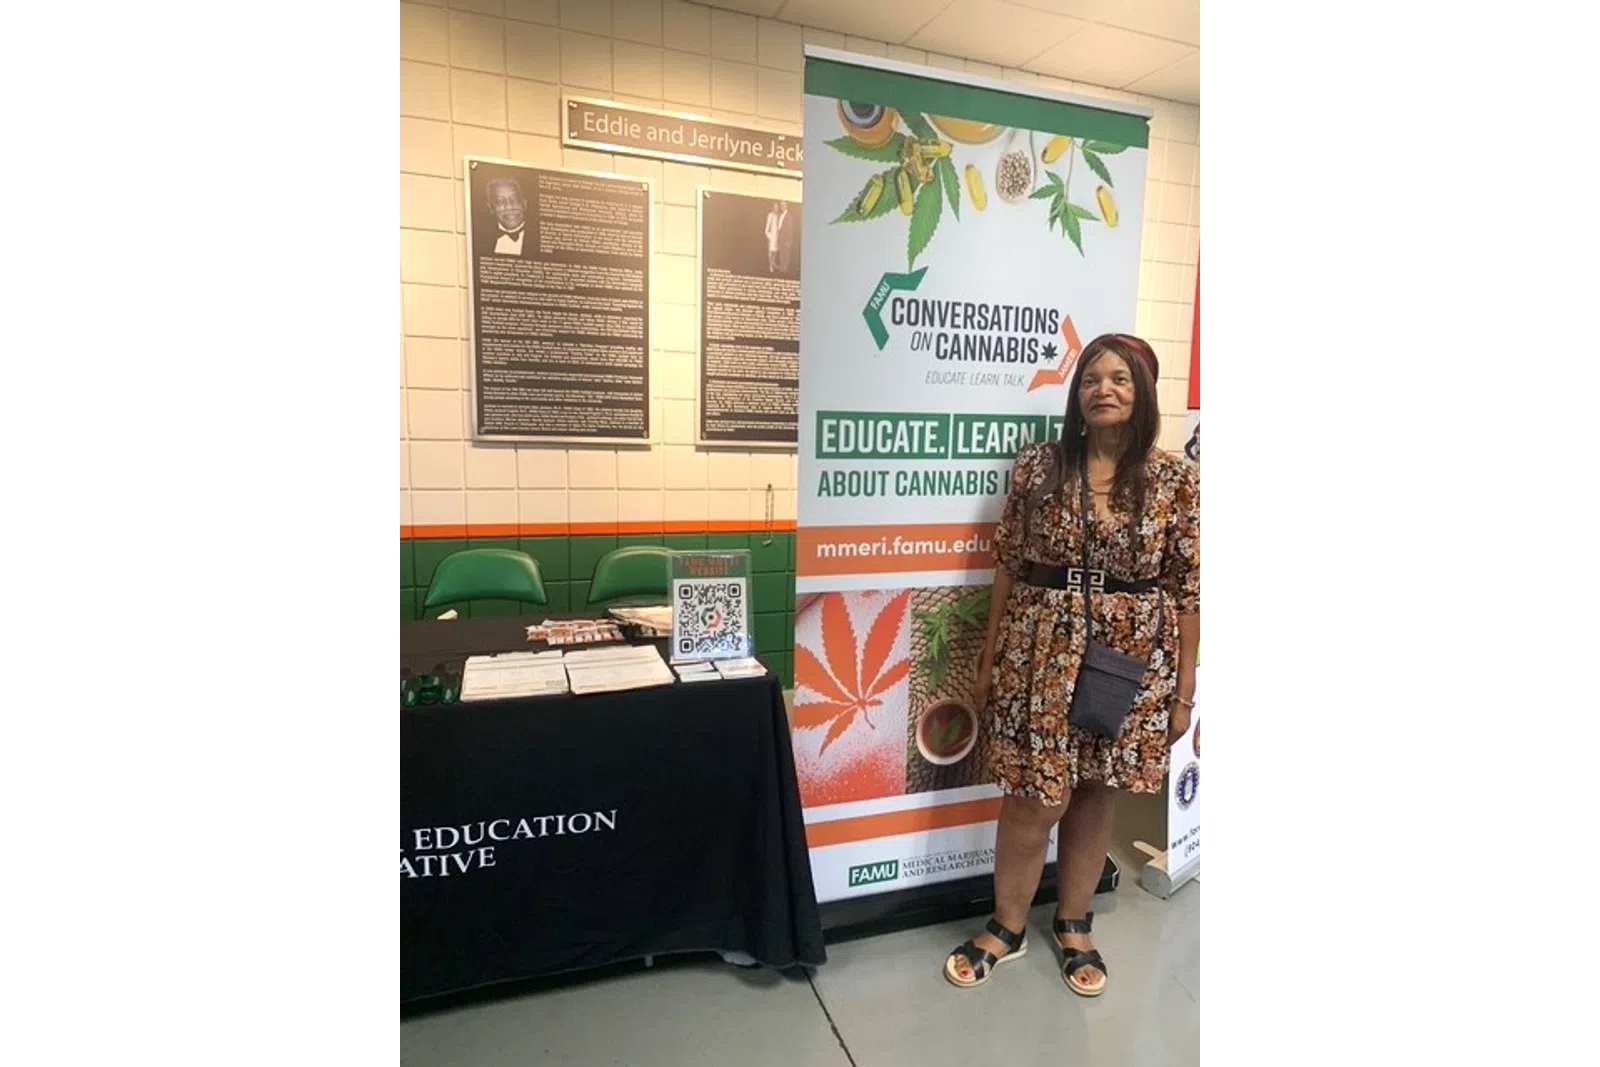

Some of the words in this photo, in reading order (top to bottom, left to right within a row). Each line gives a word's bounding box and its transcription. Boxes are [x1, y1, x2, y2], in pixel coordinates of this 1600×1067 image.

[583, 111, 641, 139] Eddie
[646, 125, 683, 145] and
[688, 128, 763, 158] Jerrlyne
[767, 140, 803, 163] Jack
[870, 279, 890, 310] FAMU
[891, 297, 1059, 335] CONVERSATIONS
[910, 330, 933, 351] ON
[935, 333, 1039, 364] CANNABIS
[1003, 373, 1025, 386] TALK
[821, 418, 946, 454] EDUCATE.
[817, 470, 889, 497] ABOUT
[895, 470, 998, 496] CANNABIS
[816, 534, 991, 558] mmeri.famu.edu
[412, 809, 618, 851] EDUCATION
[851, 862, 896, 884] FAMU
[902, 868, 925, 878] AND
[926, 860, 974, 875] RESEARCH
[903, 855, 946, 869] MEDICAL
